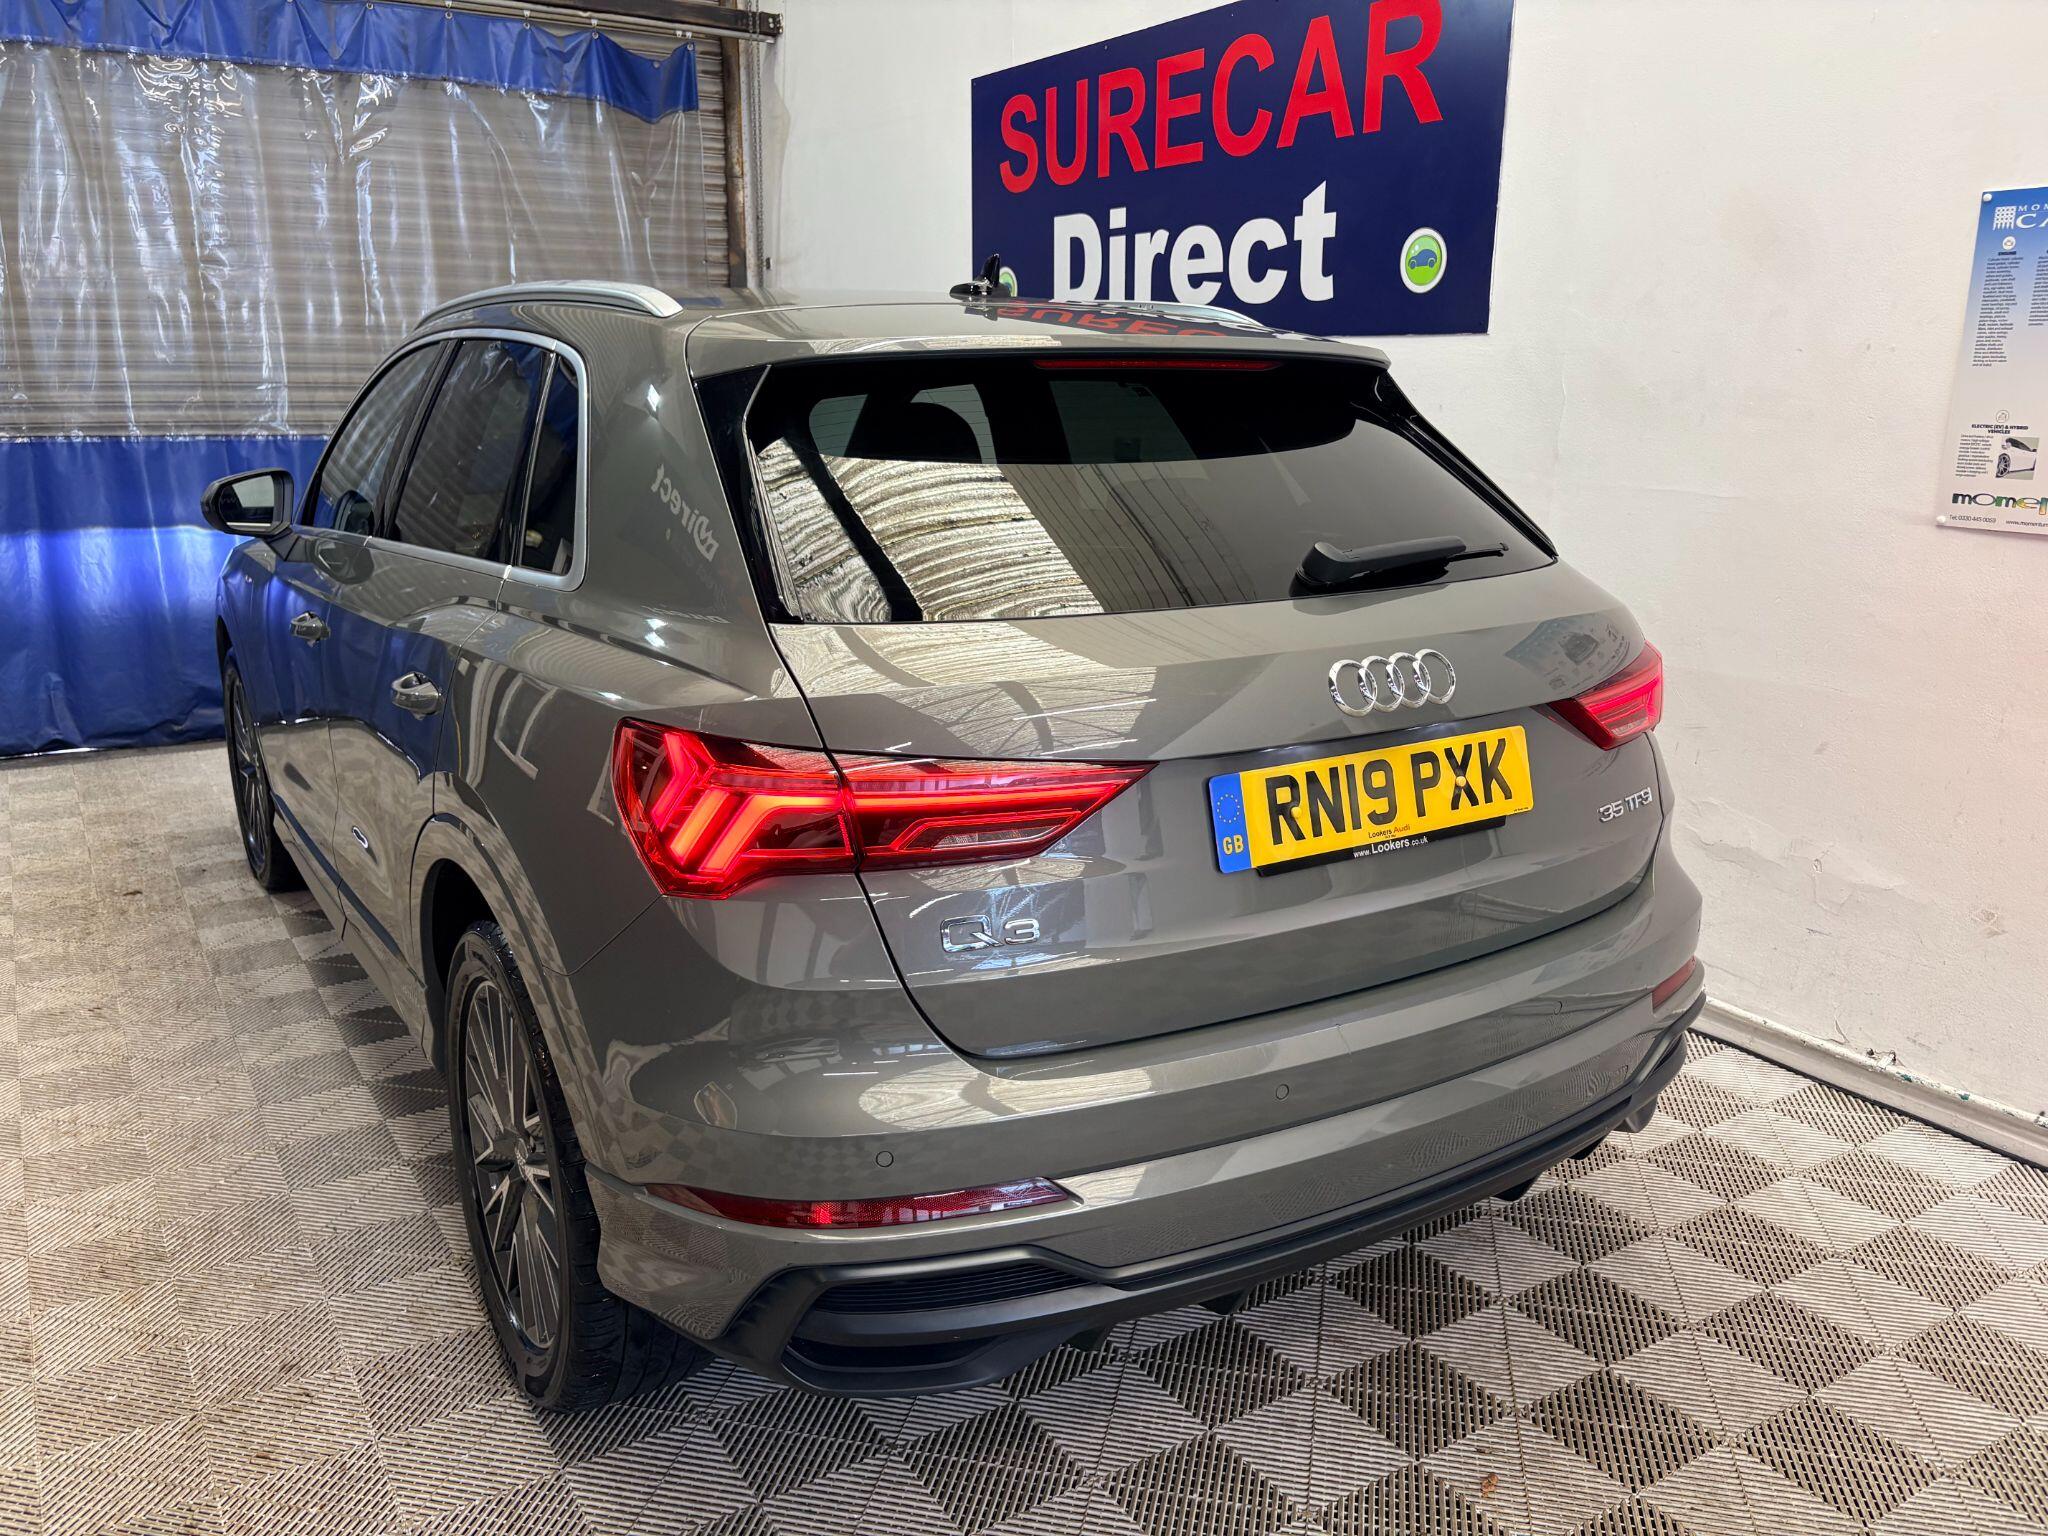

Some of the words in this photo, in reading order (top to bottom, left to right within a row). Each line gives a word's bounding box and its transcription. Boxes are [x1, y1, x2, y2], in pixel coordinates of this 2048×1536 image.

[1000, 0, 1444, 194] SURECAR
[1051, 180, 1337, 304] Direct
[1265, 759, 1398, 846] RN19
[1409, 738, 1513, 818] PXK
[1597, 800, 1624, 823] 35
[1624, 786, 1653, 812] TFSI
[1222, 834, 1245, 855] GB
[1368, 829, 1393, 839] Lookers
[1393, 823, 1411, 834] Audi
[940, 914, 1042, 953] Q3
